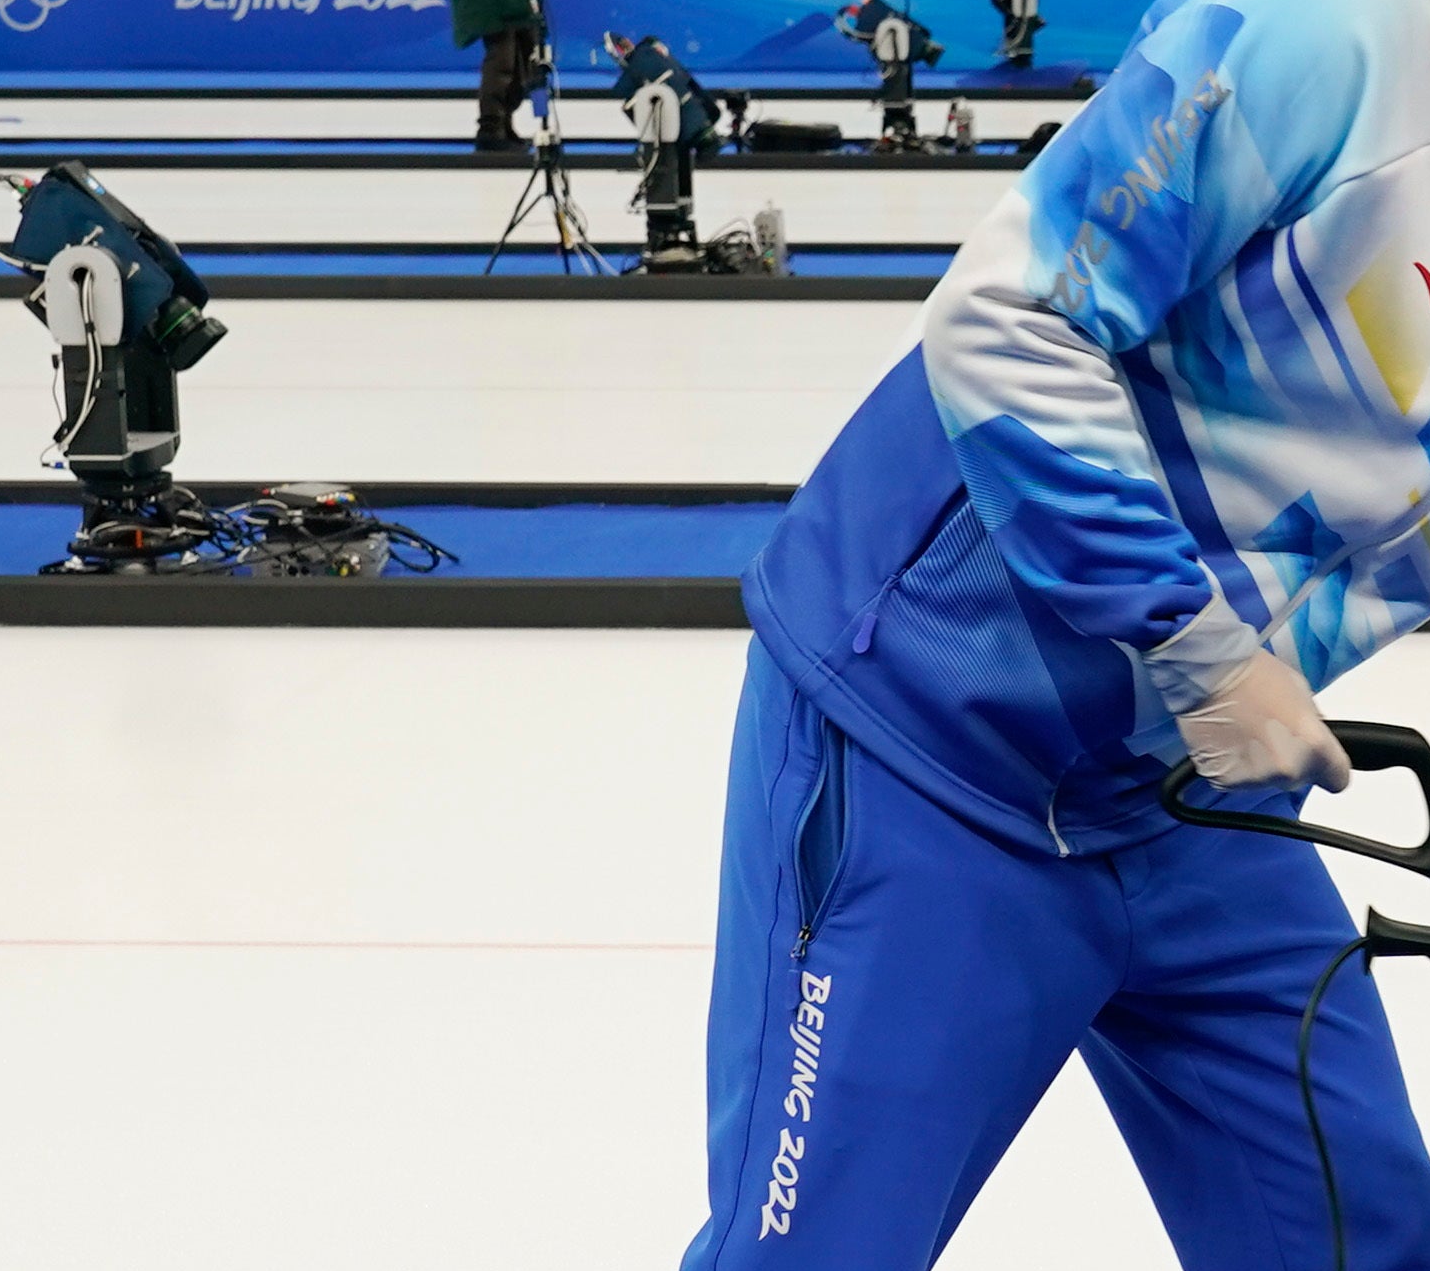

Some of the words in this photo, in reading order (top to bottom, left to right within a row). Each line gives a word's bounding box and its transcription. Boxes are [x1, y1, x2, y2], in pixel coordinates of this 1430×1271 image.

[1050, 219, 1111, 314] 202
[783, 970, 832, 1123] BEIJING
[758, 1127, 806, 1242] 2022
